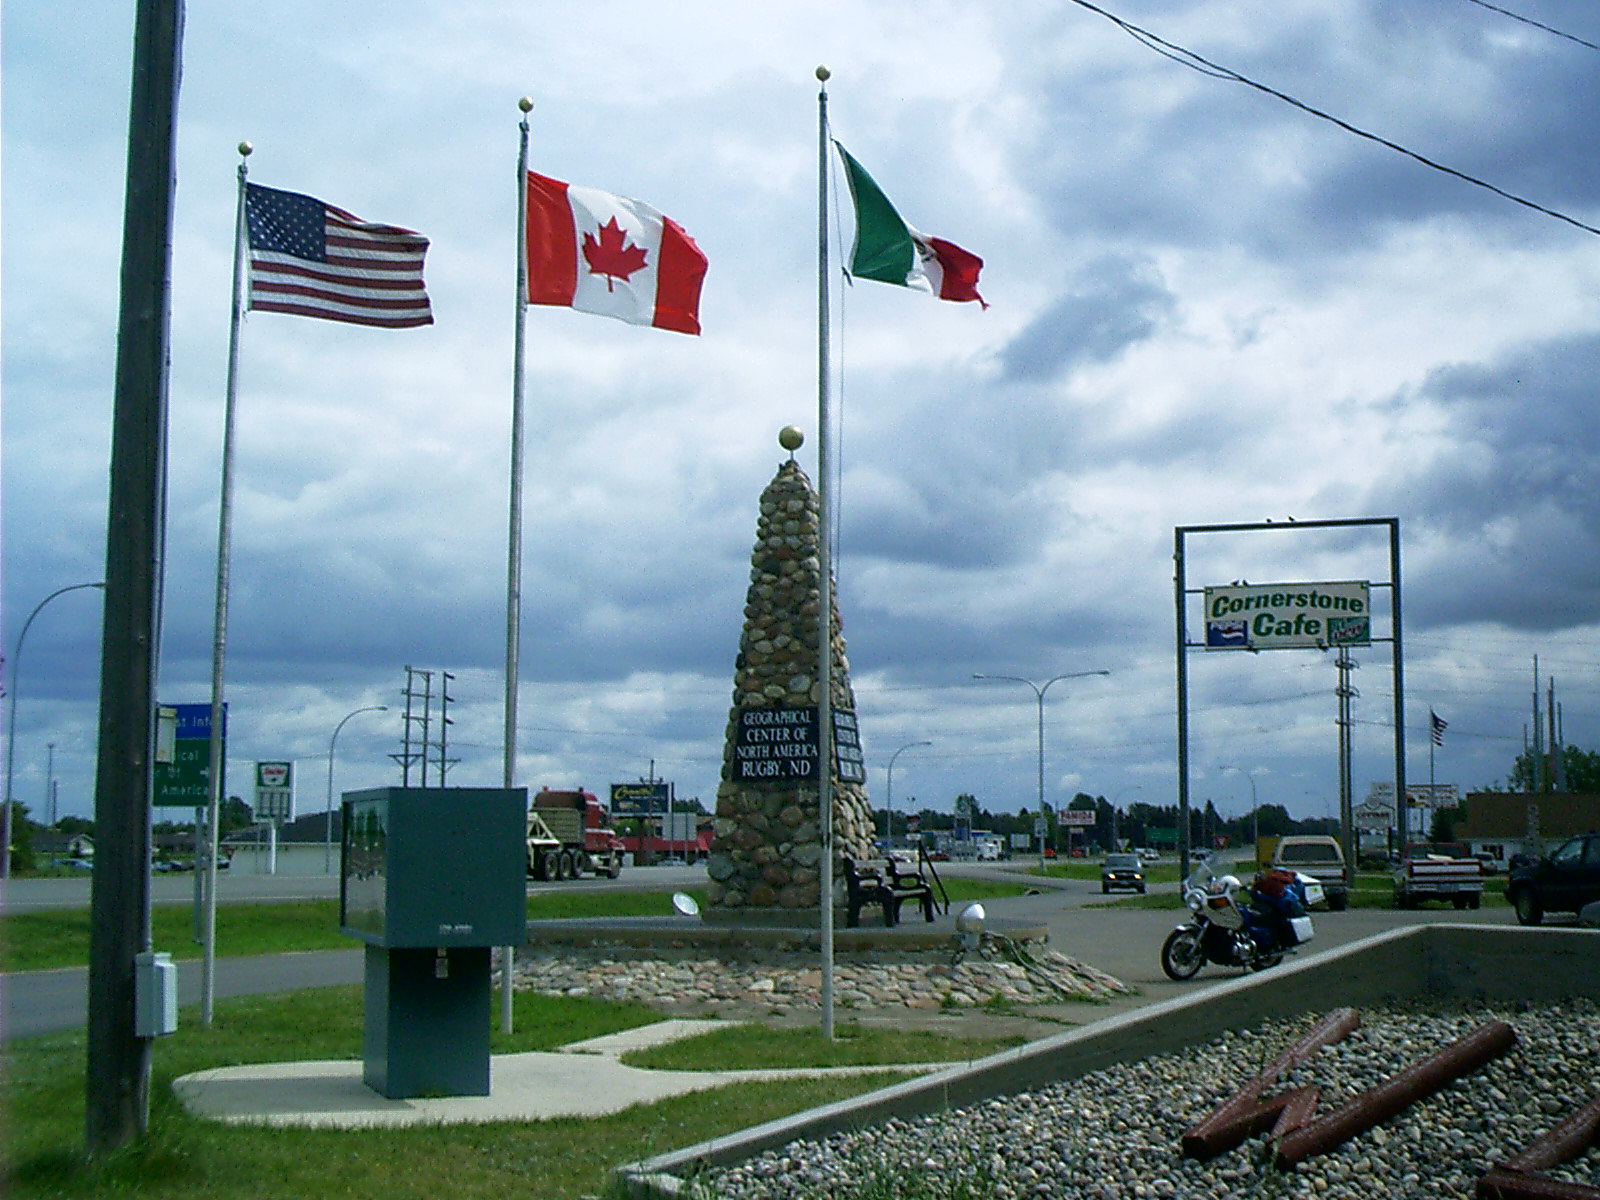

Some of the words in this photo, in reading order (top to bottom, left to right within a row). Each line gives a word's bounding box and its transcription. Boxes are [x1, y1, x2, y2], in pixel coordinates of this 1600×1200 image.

[1211, 590, 1364, 618] Cornerstone
[1252, 613, 1321, 637] Cafe
[743, 710, 811, 725] GEOGRAPHICAL
[746, 730, 790, 743] CENTER
[793, 727, 808, 741] OF
[736, 746, 770, 760] NORTH
[772, 744, 818, 758] AMERICA
[742, 761, 786, 777] RUGBY,
[790, 760, 811, 775] ND
